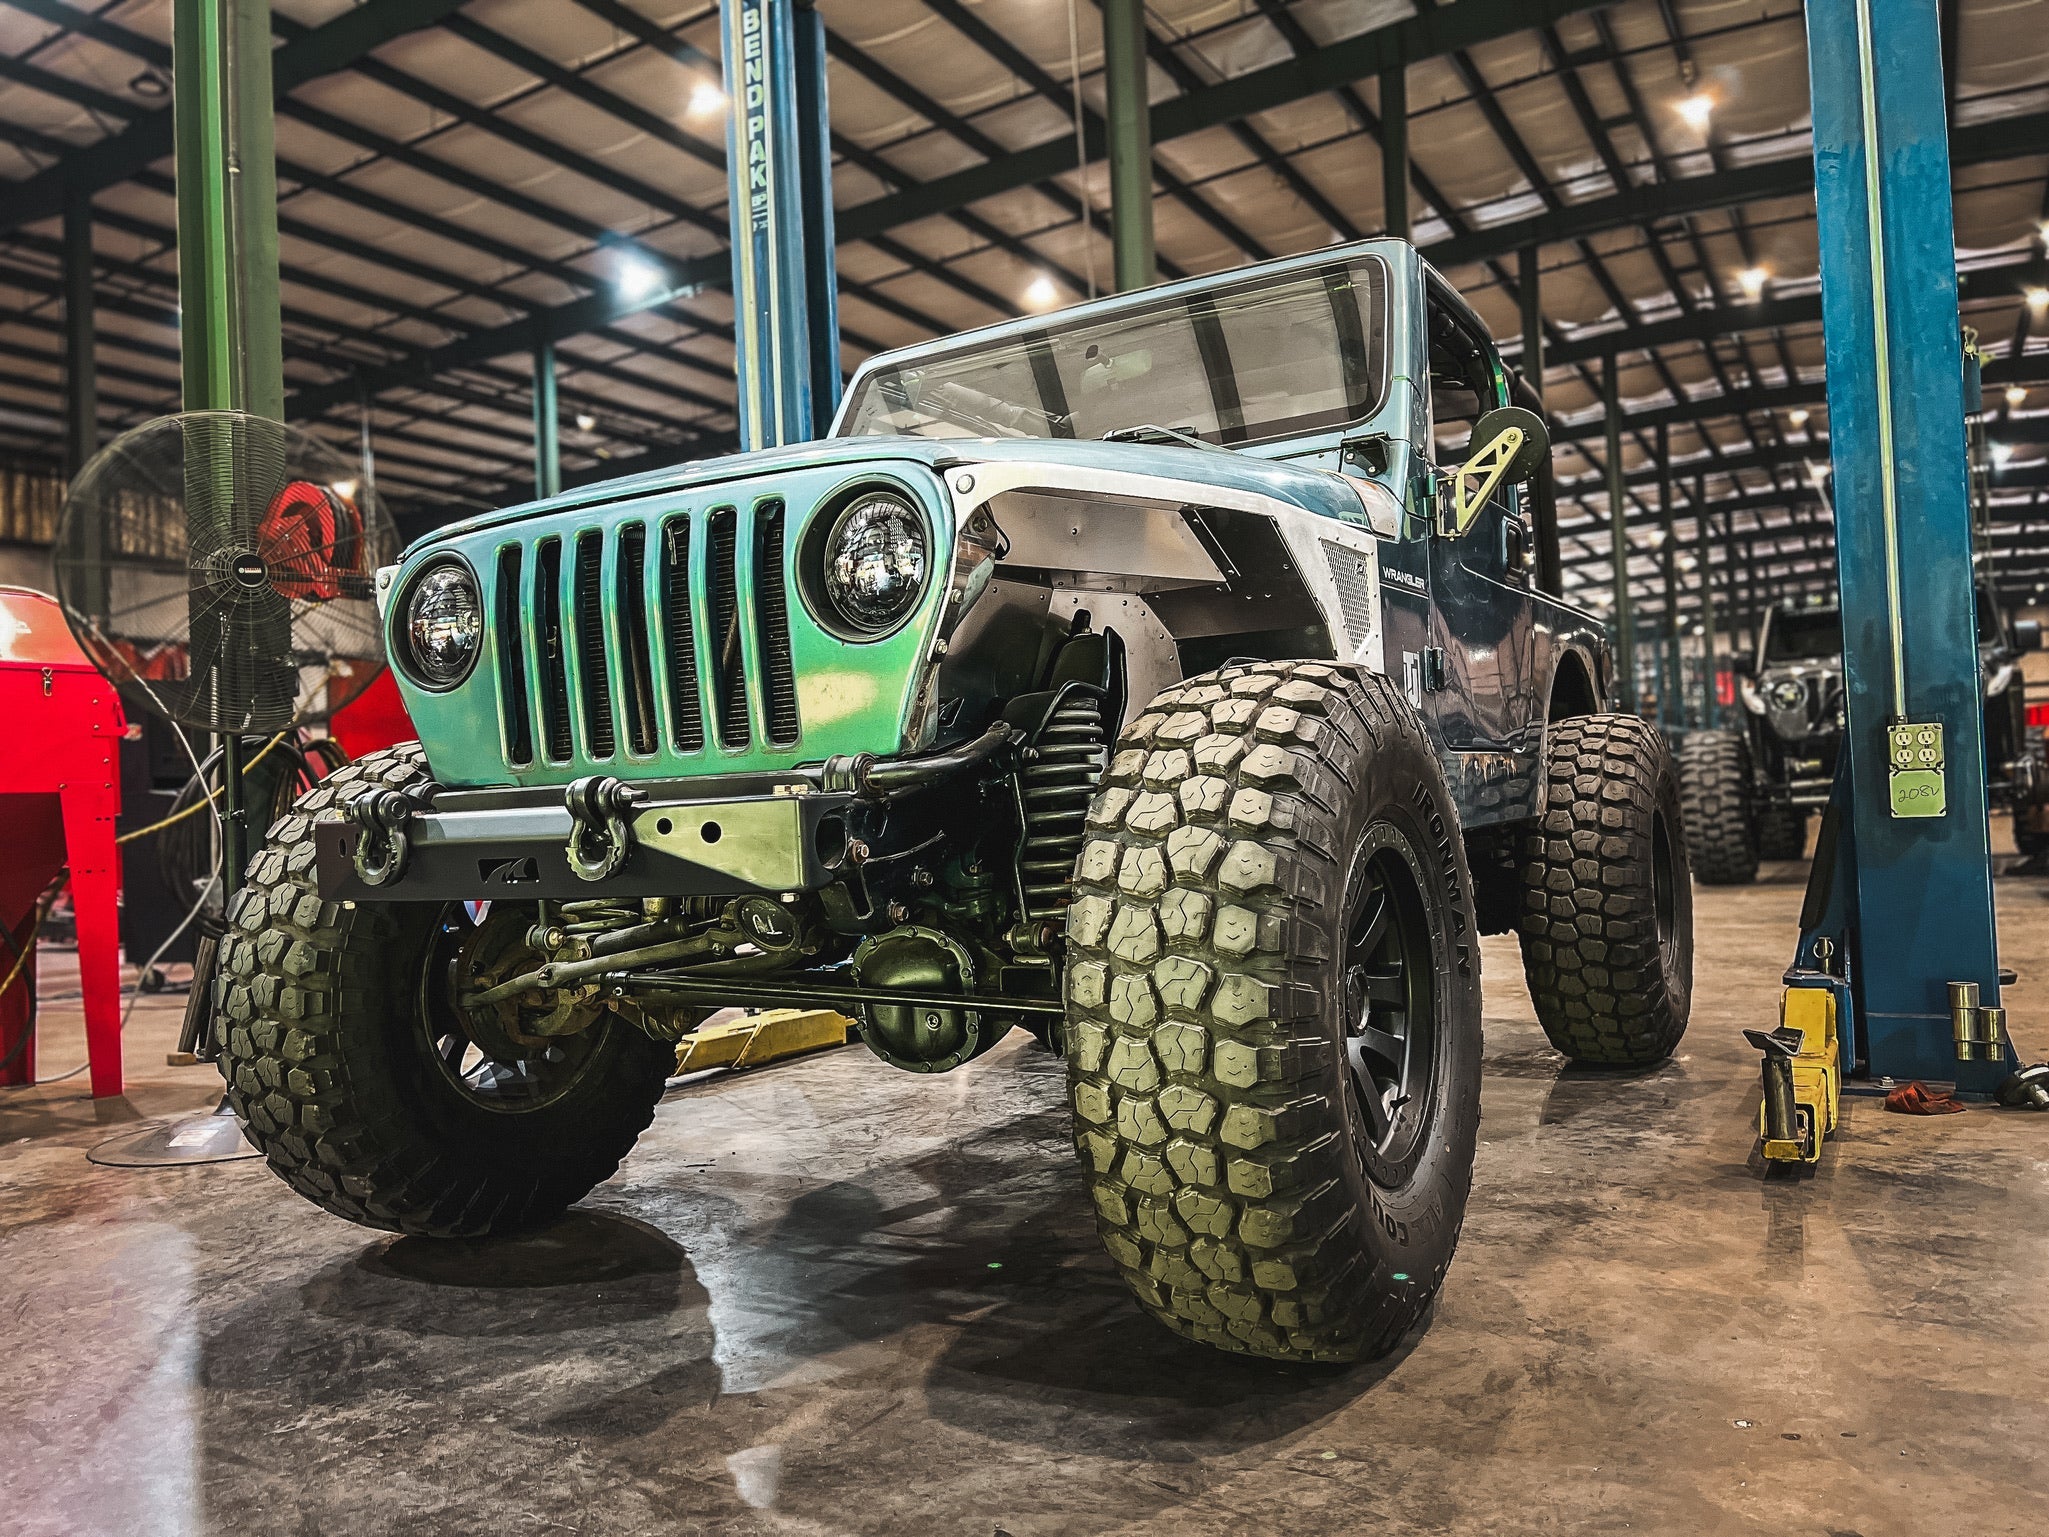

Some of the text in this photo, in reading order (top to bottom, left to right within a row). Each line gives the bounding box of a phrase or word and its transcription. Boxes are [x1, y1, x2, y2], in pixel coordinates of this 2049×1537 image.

[1382, 566, 1426, 590] WRANGLER
[1402, 651, 1422, 709] TJ
[1412, 780, 1472, 979] IRONMAN
